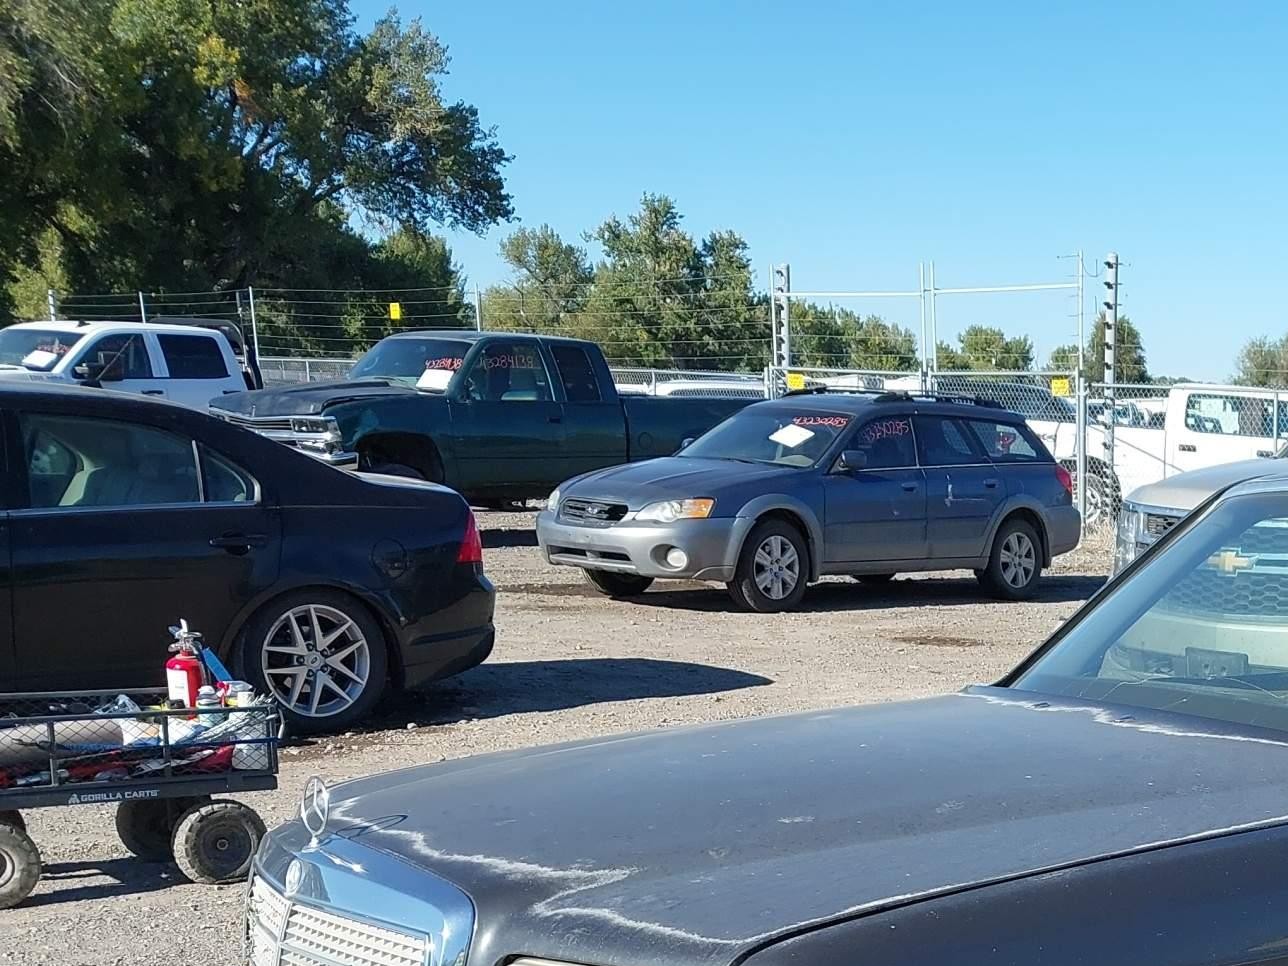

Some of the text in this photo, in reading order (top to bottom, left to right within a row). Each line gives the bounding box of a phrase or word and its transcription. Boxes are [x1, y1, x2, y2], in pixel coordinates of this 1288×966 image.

[792, 416, 848, 427] 43230285
[81, 790, 158, 801] GORILLA CARTS
